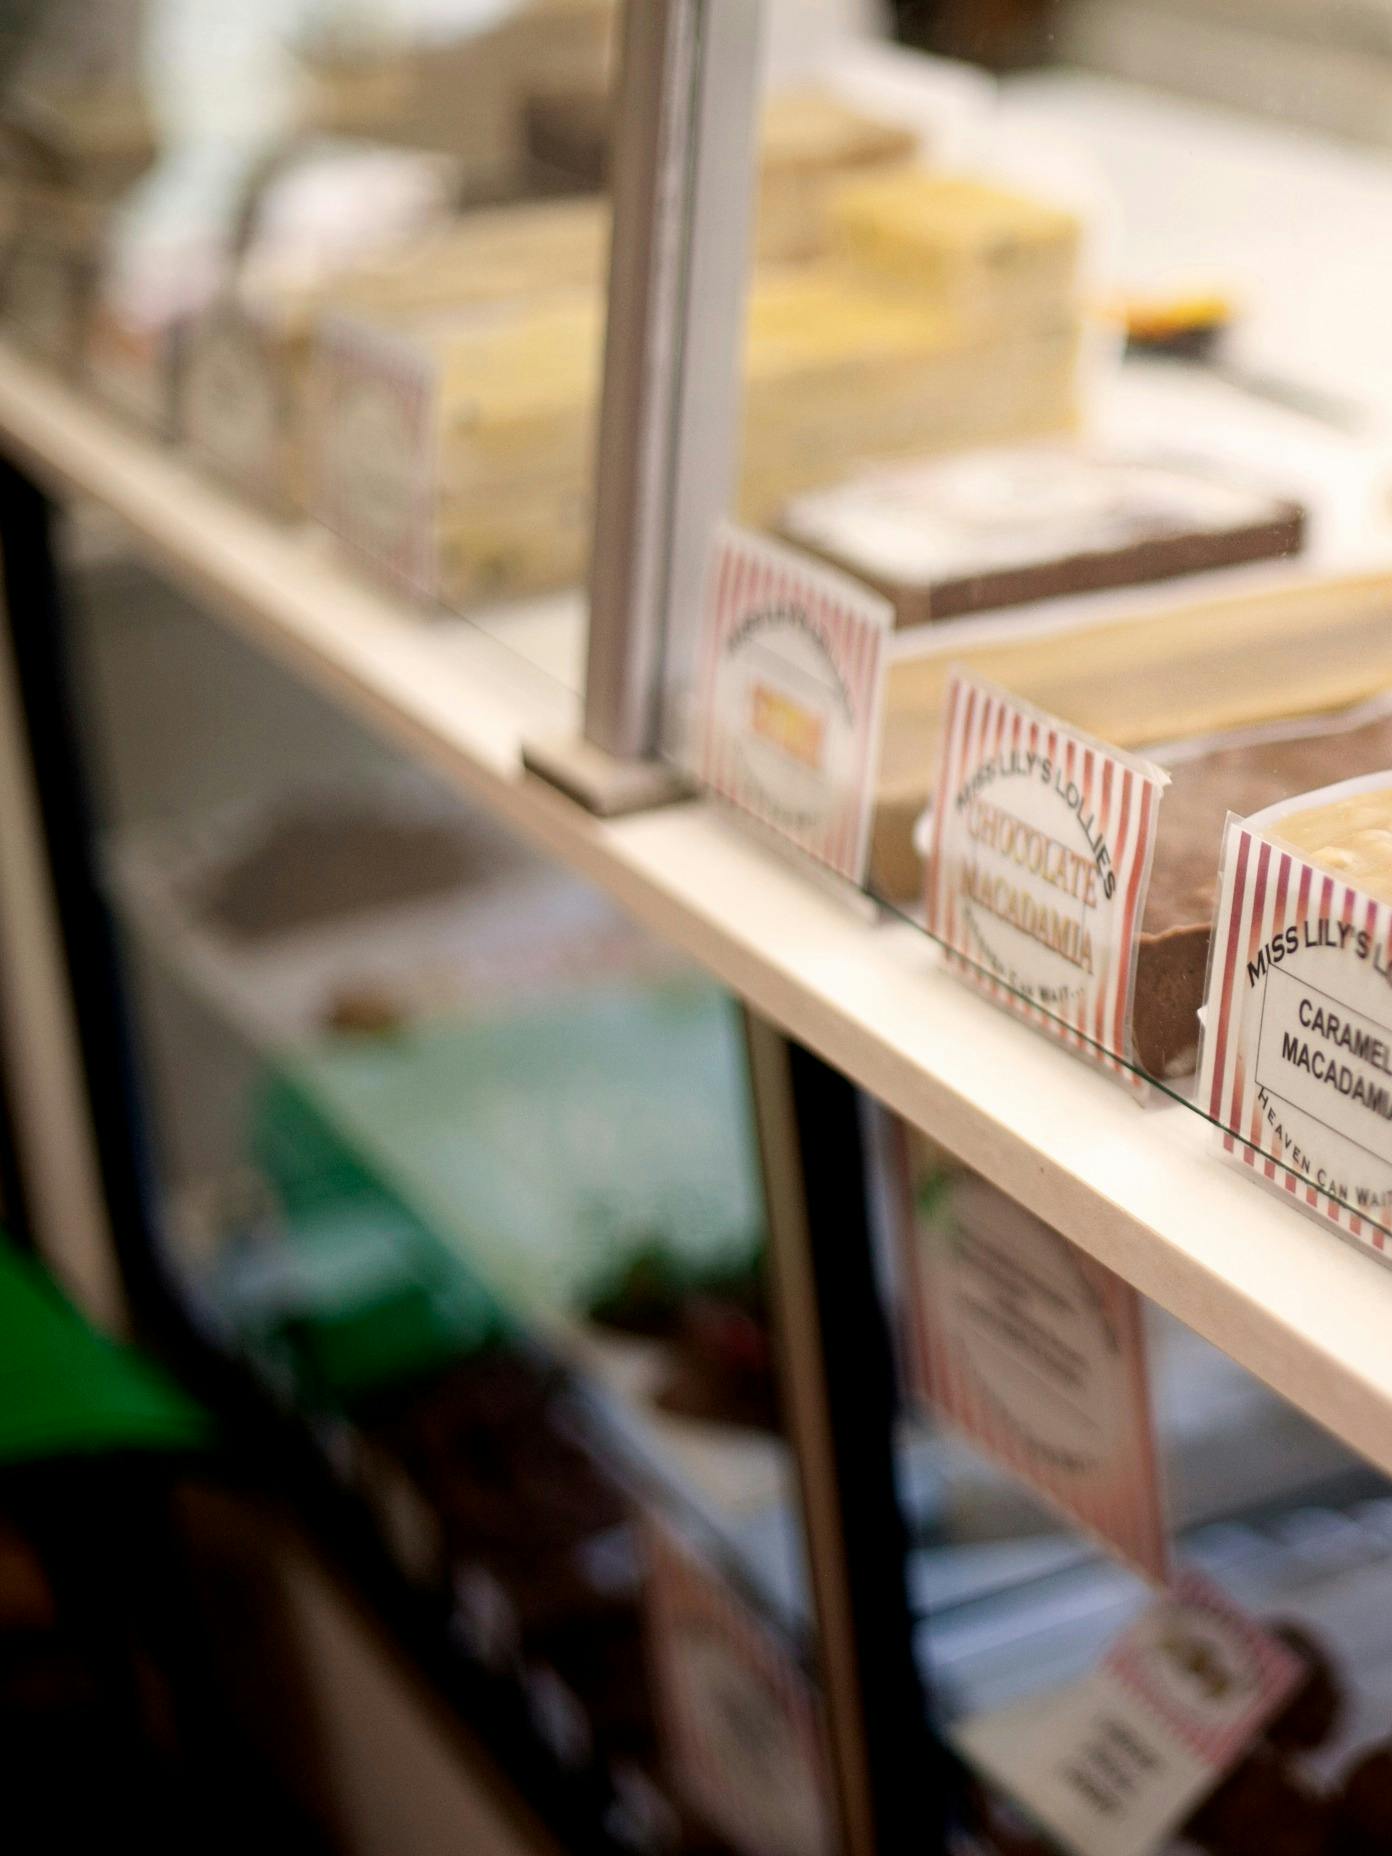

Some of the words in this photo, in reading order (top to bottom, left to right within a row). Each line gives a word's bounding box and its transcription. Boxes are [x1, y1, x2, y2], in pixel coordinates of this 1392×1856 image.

[967, 798, 1098, 908] CHOCOLATE
[999, 749, 1052, 784] LILY'S
[1055, 767, 1117, 900] LOLLIES
[960, 852, 1094, 976] MACADAMIA
[1246, 925, 1299, 989] MISS
[1303, 917, 1370, 960] LILY'S
[1256, 1086, 1311, 1175] HEAVEN
[1316, 1168, 1348, 1201] CAN
